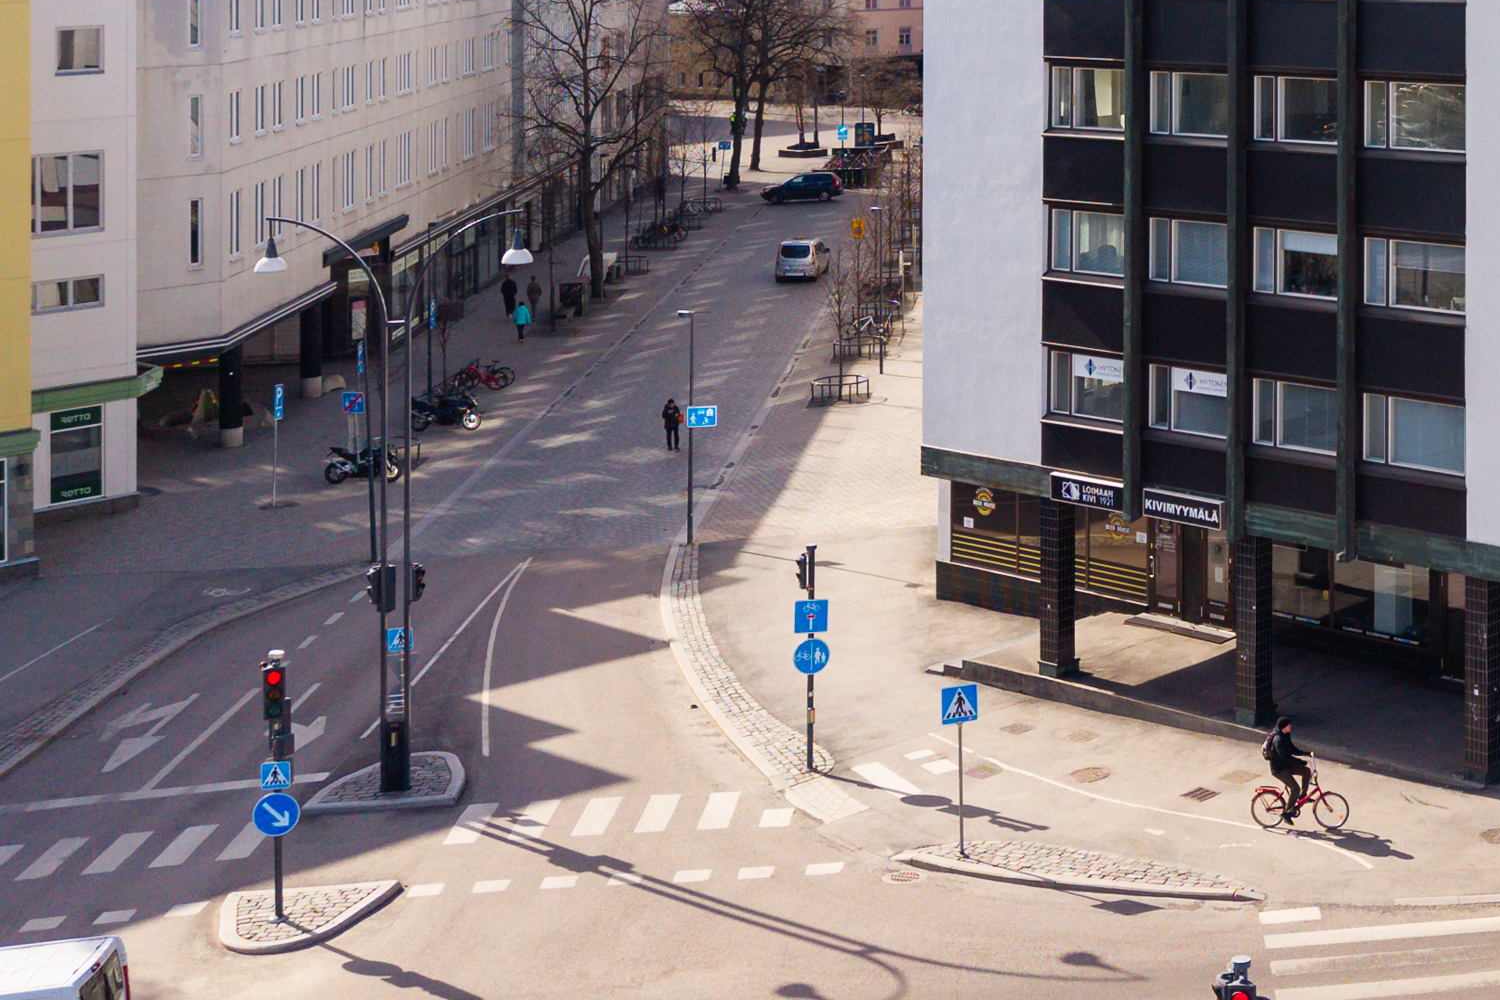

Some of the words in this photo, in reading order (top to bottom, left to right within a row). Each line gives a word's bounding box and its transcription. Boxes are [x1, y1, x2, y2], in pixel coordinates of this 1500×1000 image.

[1082, 494, 1096, 504] KIVI
[1099, 496, 1114, 507] 1921
[1145, 498, 1219, 524] KIVIMYYMÄLÄ
